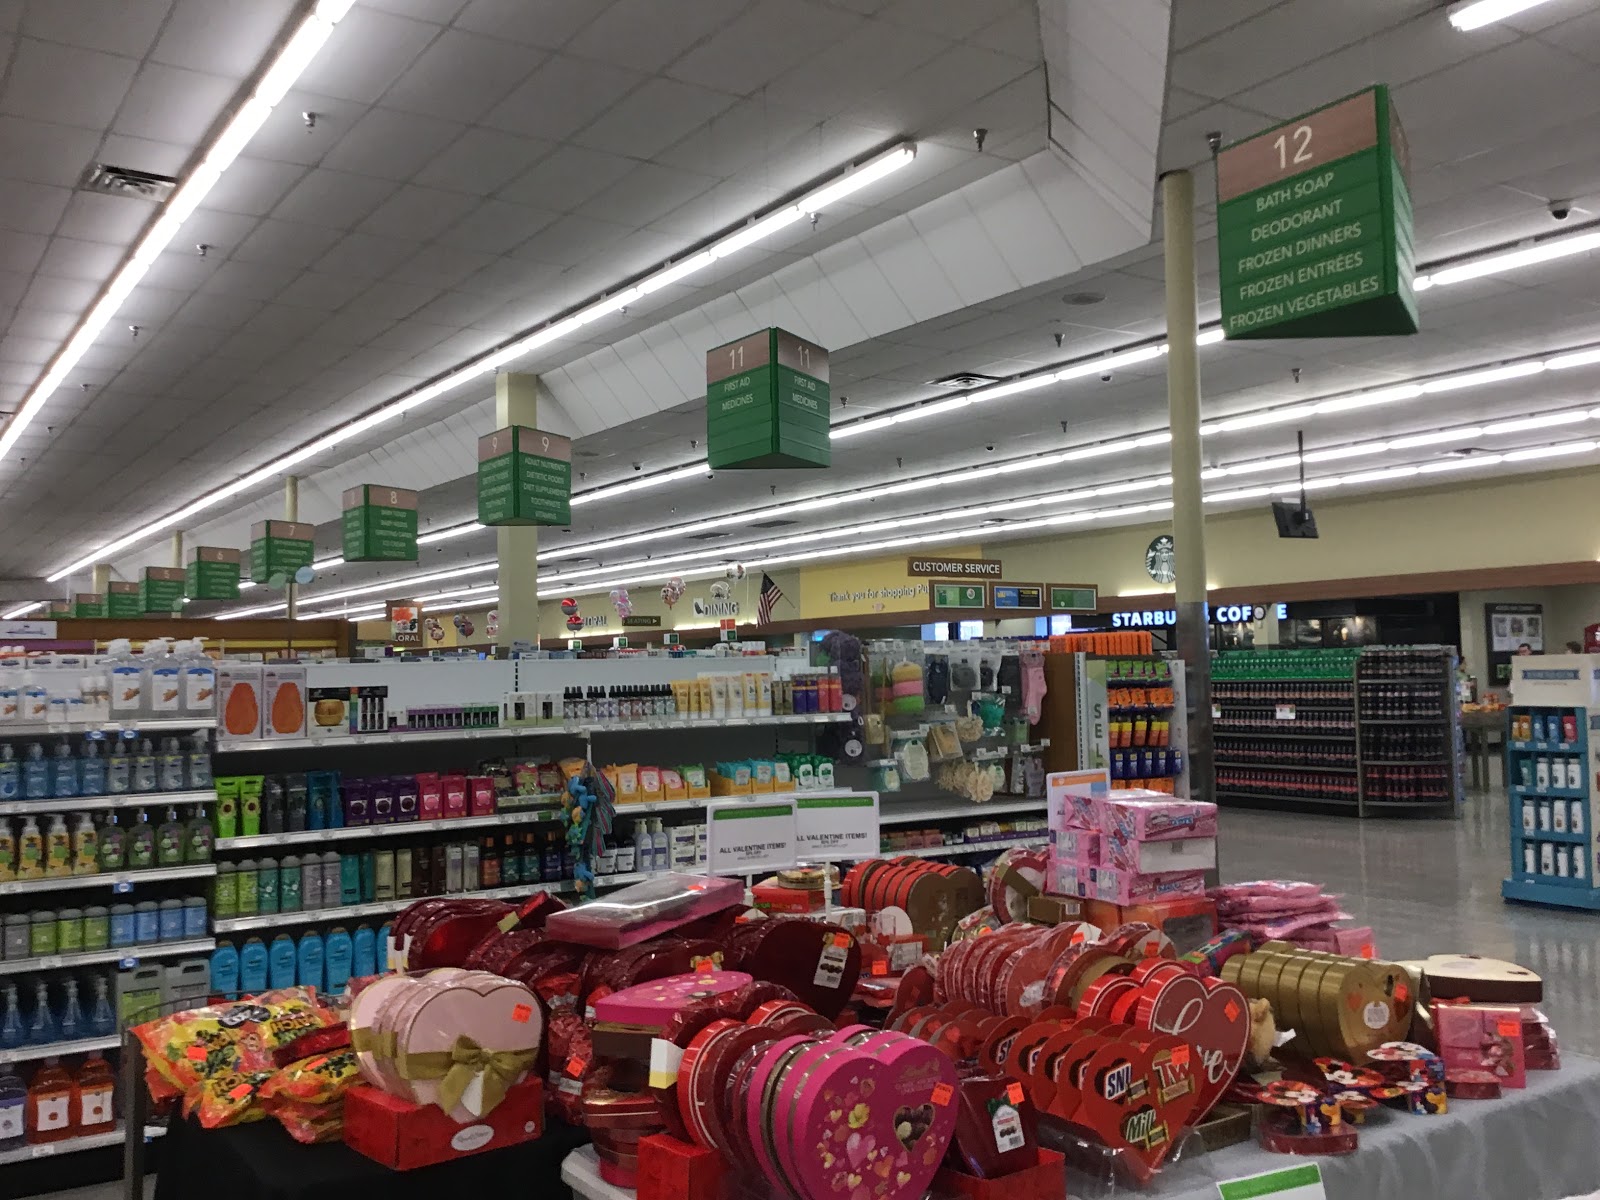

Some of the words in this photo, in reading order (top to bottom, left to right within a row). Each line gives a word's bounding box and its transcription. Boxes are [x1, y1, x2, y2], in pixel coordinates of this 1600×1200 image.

[1274, 125, 1313, 169] 12
[1256, 187, 1291, 212] BATH
[1294, 172, 1334, 199] SOAP
[1251, 199, 1343, 242] DEODORANT
[1238, 246, 1292, 274] FROZEN
[1296, 222, 1362, 255] DINNERS
[1240, 273, 1294, 300] FROZEN
[1229, 303, 1284, 329] FROZEN
[1287, 275, 1379, 314] VEGETABLES
[729, 345, 744, 370] 11
[797, 345, 810, 369] 11
[724, 380, 738, 392] FIRST
[739, 377, 751, 387] AID
[794, 375, 806, 388] FIRST
[807, 381, 816, 391] AID
[721, 393, 753, 411] MEDICINES
[792, 393, 818, 410] MEDICINES
[492, 436, 498, 453] 9
[541, 436, 550, 452] 9
[390, 491, 398, 504] 8
[289, 525, 295, 536] 7
[912, 561, 963, 573] CUSTOMER
[964, 563, 1000, 574] SERVICE
[830, 591, 851, 603] Thank
[852, 592, 866, 603] you
[867, 588, 879, 599] for
[880, 585, 916, 599] shopping
[1112, 609, 1209, 627] STARBU
[1216, 603, 1288, 622] COFE
[806, 833, 844, 842] VALENTINE
[733, 843, 765, 853] VALENTINE
